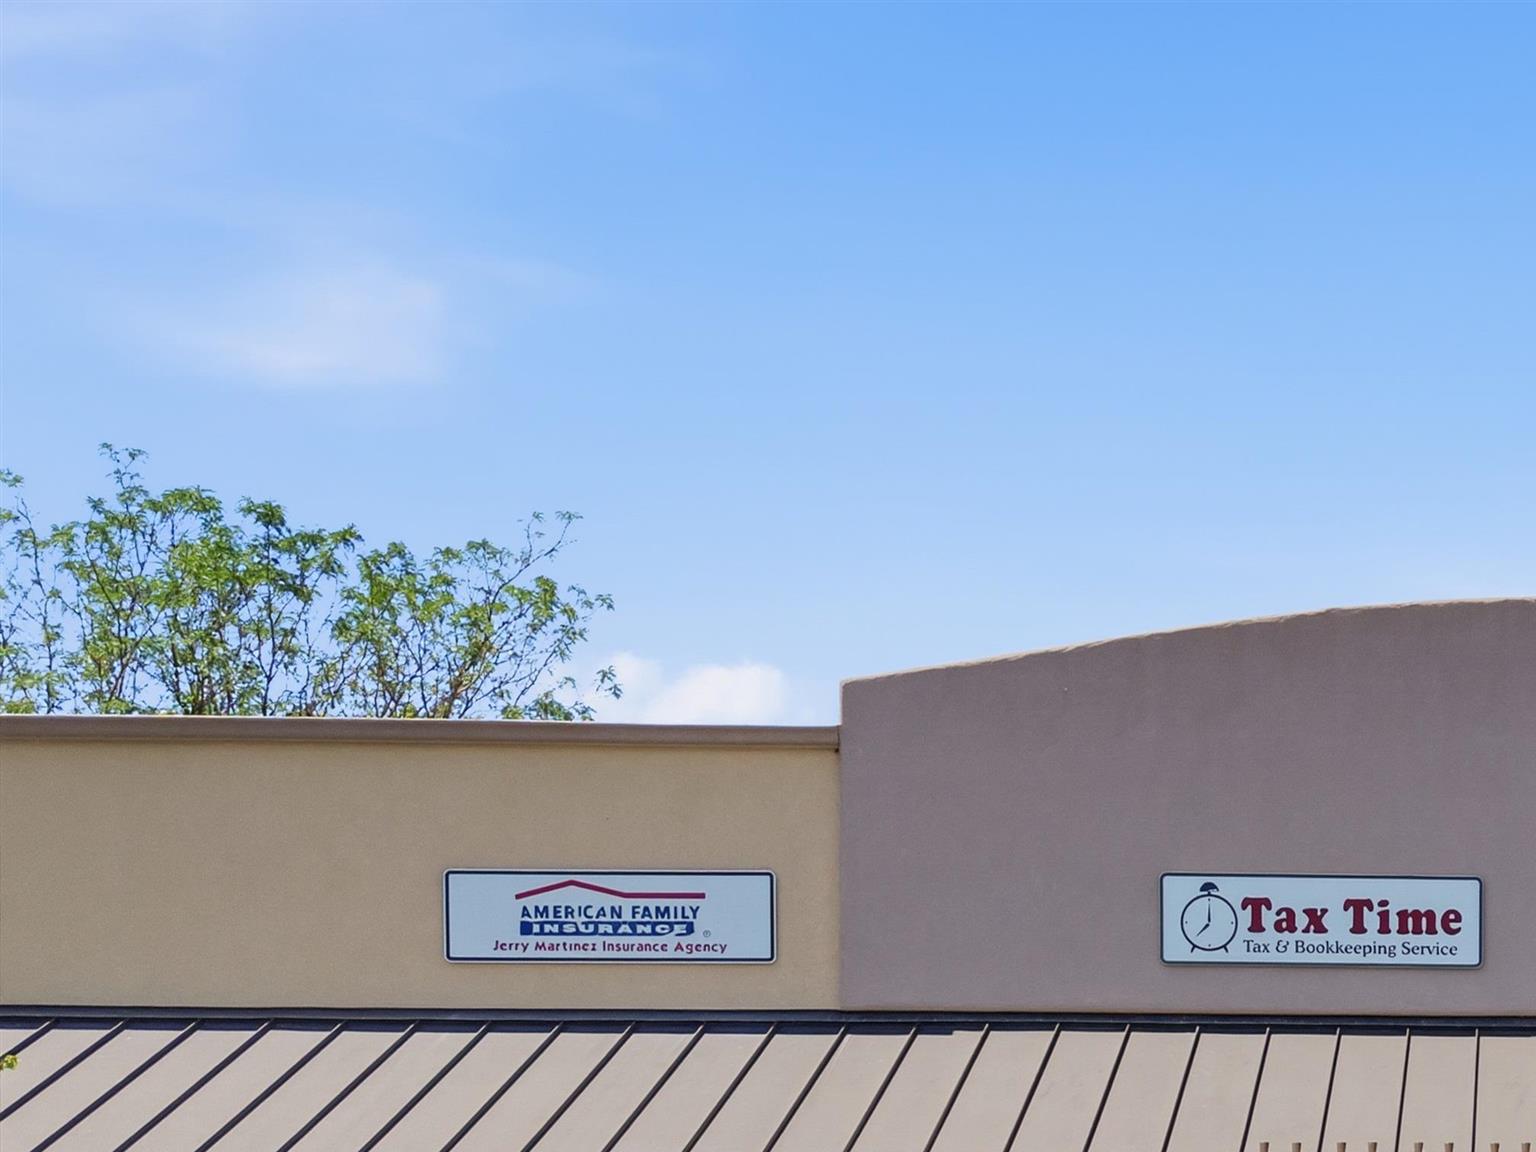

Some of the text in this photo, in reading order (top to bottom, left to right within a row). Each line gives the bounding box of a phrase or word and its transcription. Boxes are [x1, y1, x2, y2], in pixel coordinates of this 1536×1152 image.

[520, 904, 701, 920] AMERICAN FAMILY
[1241, 896, 1463, 936] Tax Time
[530, 922, 688, 936] INSURANCE
[493, 940, 728, 955] Jerry Martinez Insurance Agency
[1243, 939, 1458, 958] Tax & Bookkeeping Service
